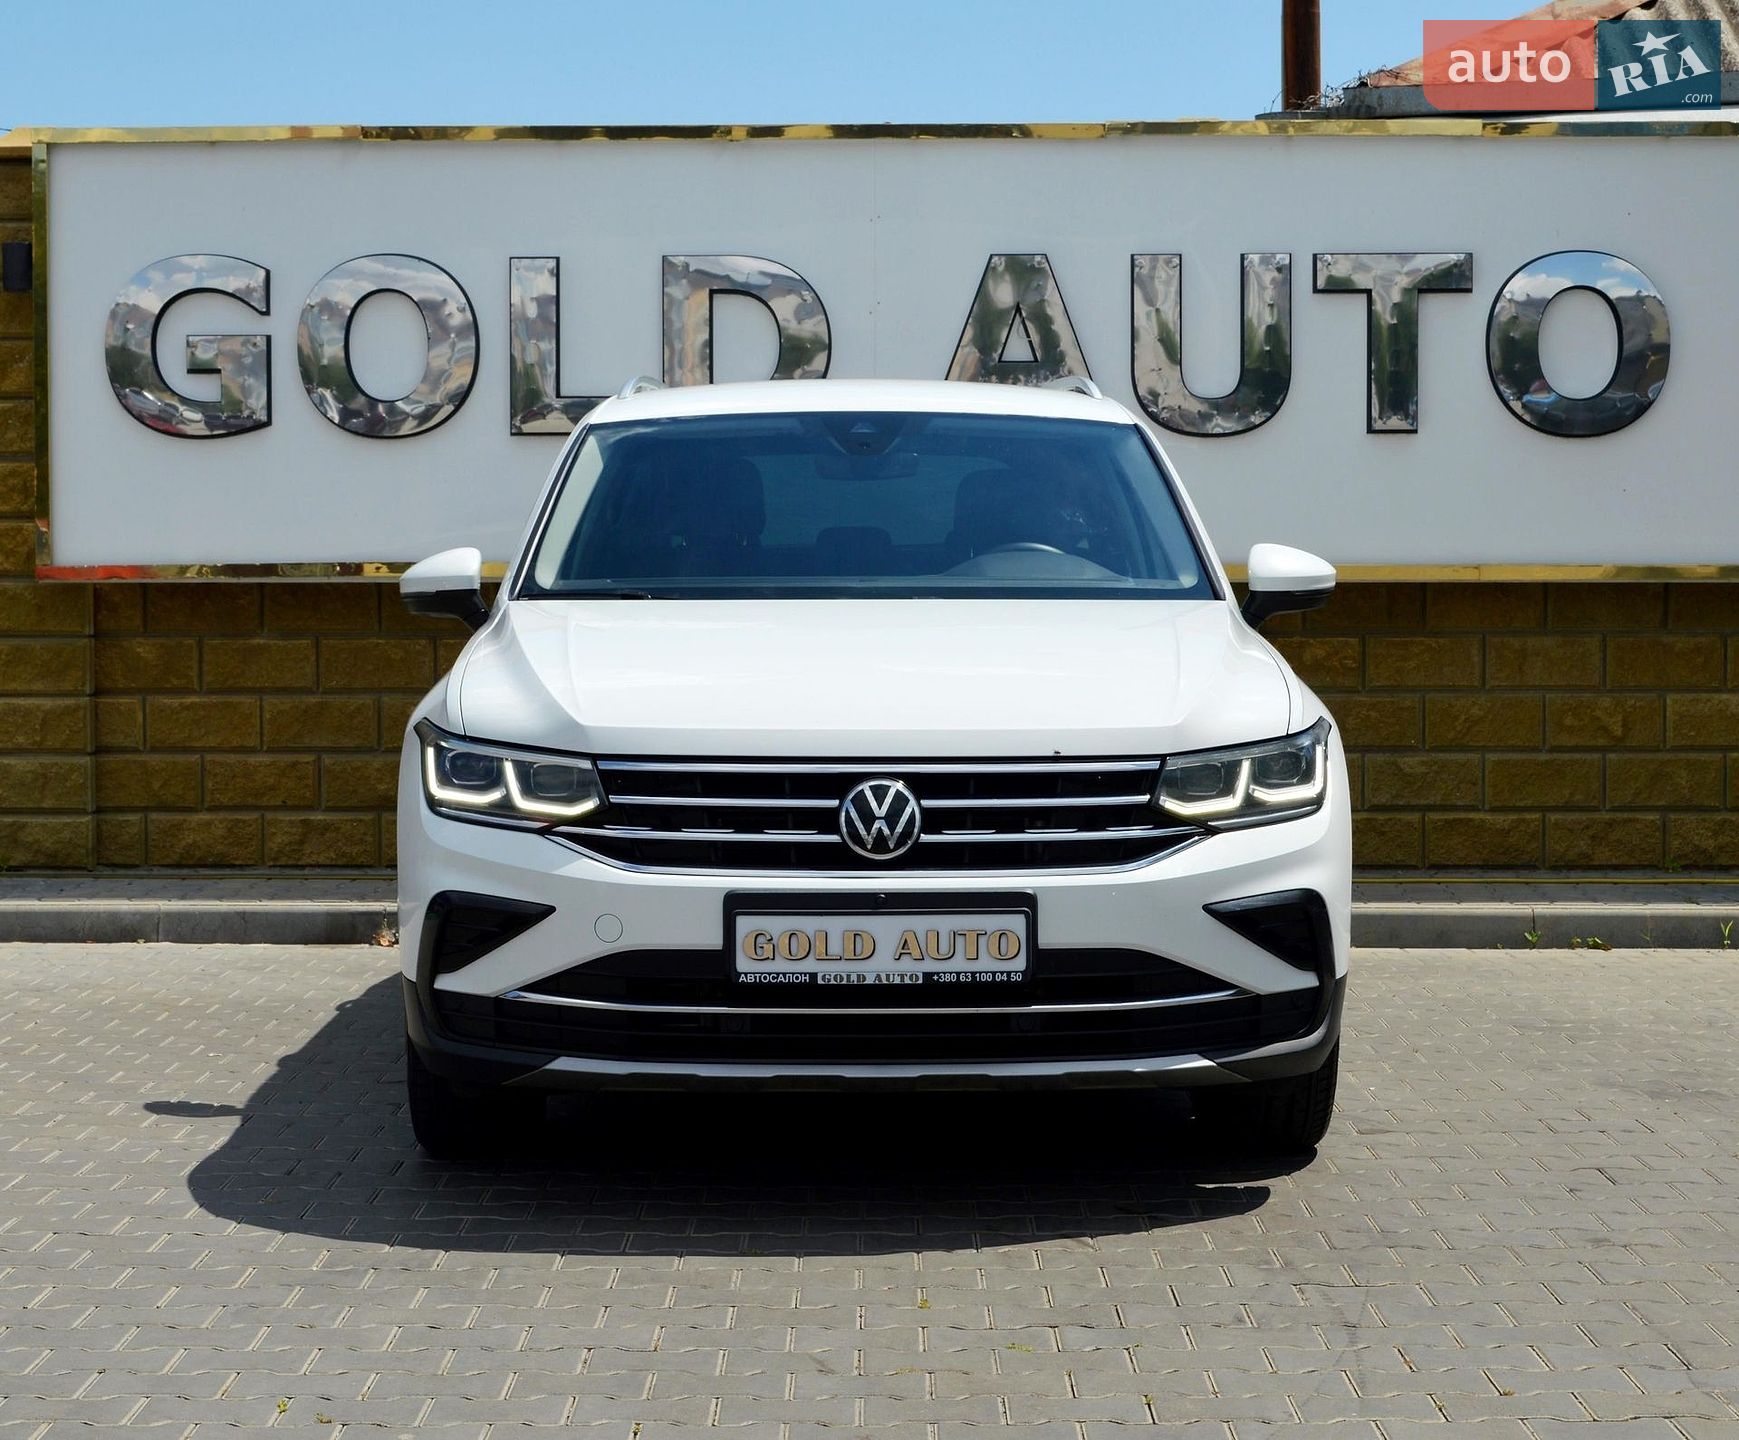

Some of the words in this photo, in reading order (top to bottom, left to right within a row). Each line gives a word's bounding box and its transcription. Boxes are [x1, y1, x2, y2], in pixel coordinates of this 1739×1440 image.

[104, 253, 832, 439] GOLD
[945, 249, 1671, 438] AUTO
[743, 929, 876, 961] GOLD
[894, 929, 1021, 961] AUTO
[739, 973, 809, 983] АВТОСАЛОН
[820, 973, 867, 984] GOLD
[873, 973, 920, 984] AUTO
[932, 973, 957, 983] +380
[959, 973, 972, 983] 63
[974, 972, 993, 982] 100
[995, 972, 1008, 982] 04
[1010, 972, 1023, 982] 50
